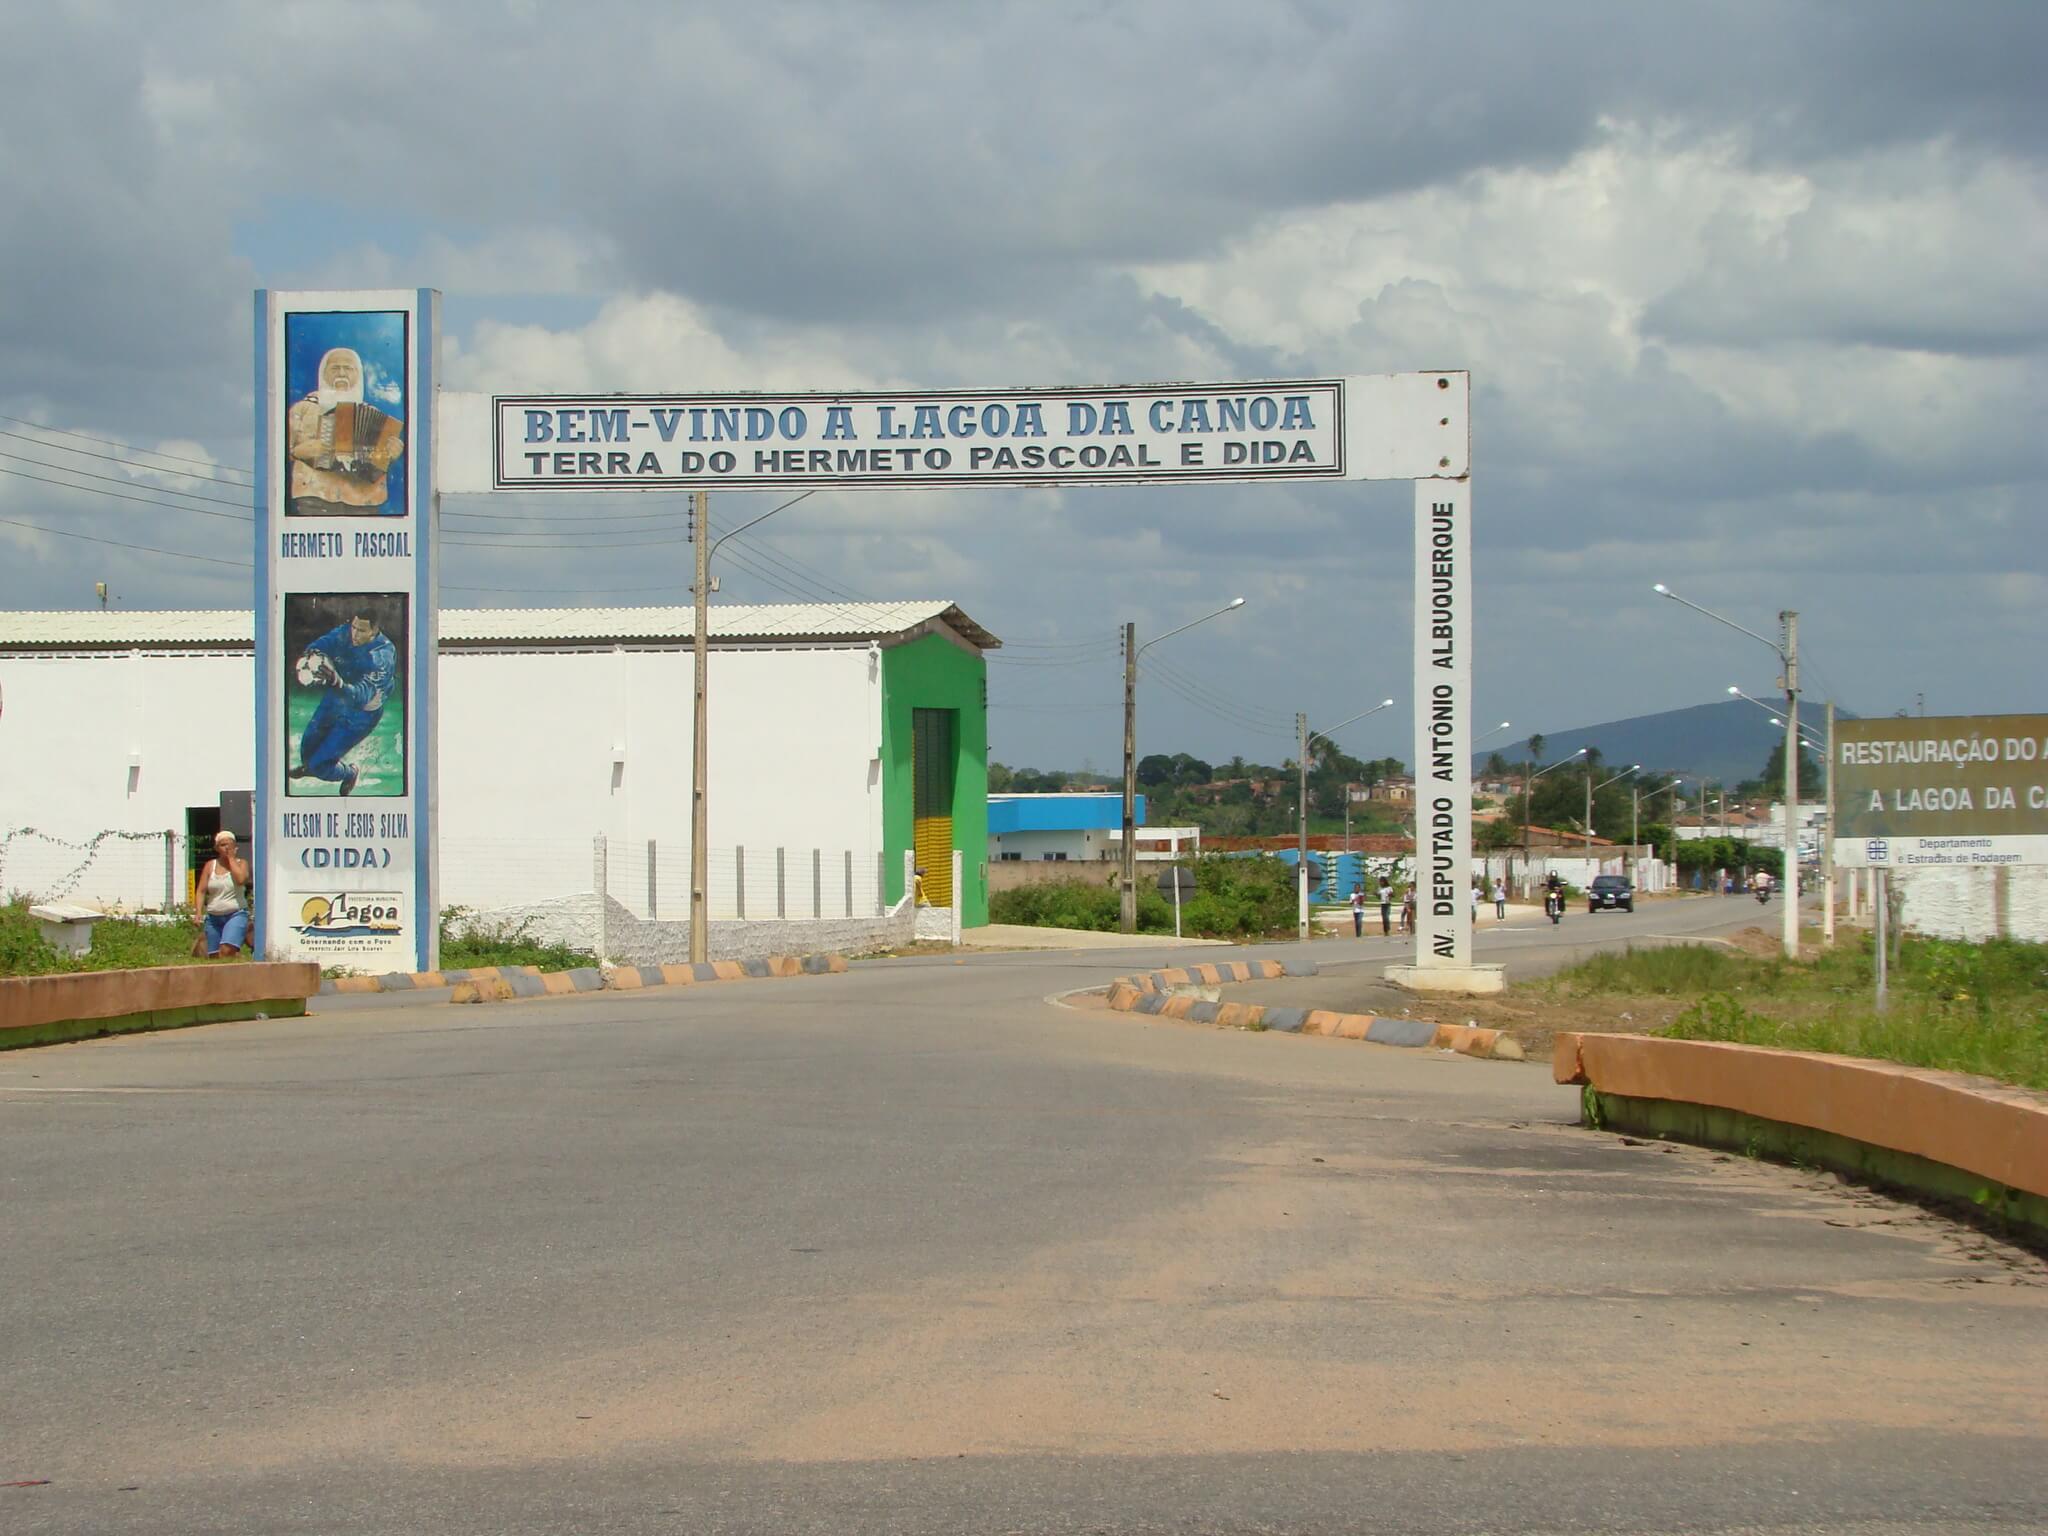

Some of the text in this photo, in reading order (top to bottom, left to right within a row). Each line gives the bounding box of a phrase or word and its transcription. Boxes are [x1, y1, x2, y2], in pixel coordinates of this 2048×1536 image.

[524, 396, 1316, 443] BEM-VINDO A LAGOA DA CANOA
[524, 439, 1316, 475] TERRA DO HERMETO PASCOAL E DIDA
[282, 532, 411, 558] HERMETO PASCOAL
[1432, 502, 1454, 669] ALBUQUERQUE
[1428, 684, 1454, 782] ANTÔNIO
[1841, 734, 1999, 768] RESTAURAÇÃO
[2006, 737, 2036, 761] DO
[1868, 785, 2048, 812] A LAGOA DA C
[283, 813, 409, 838] NELSON DE JESUS SILVA
[301, 847, 391, 869] (DIDA)
[1432, 797, 1454, 916] DEPUTADO
[1907, 853, 1953, 864] Estradas
[1956, 853, 1969, 863] de
[1972, 852, 2023, 865] Rodagem
[1919, 838, 1992, 850] Departamento
[327, 892, 398, 924] Lagoa
